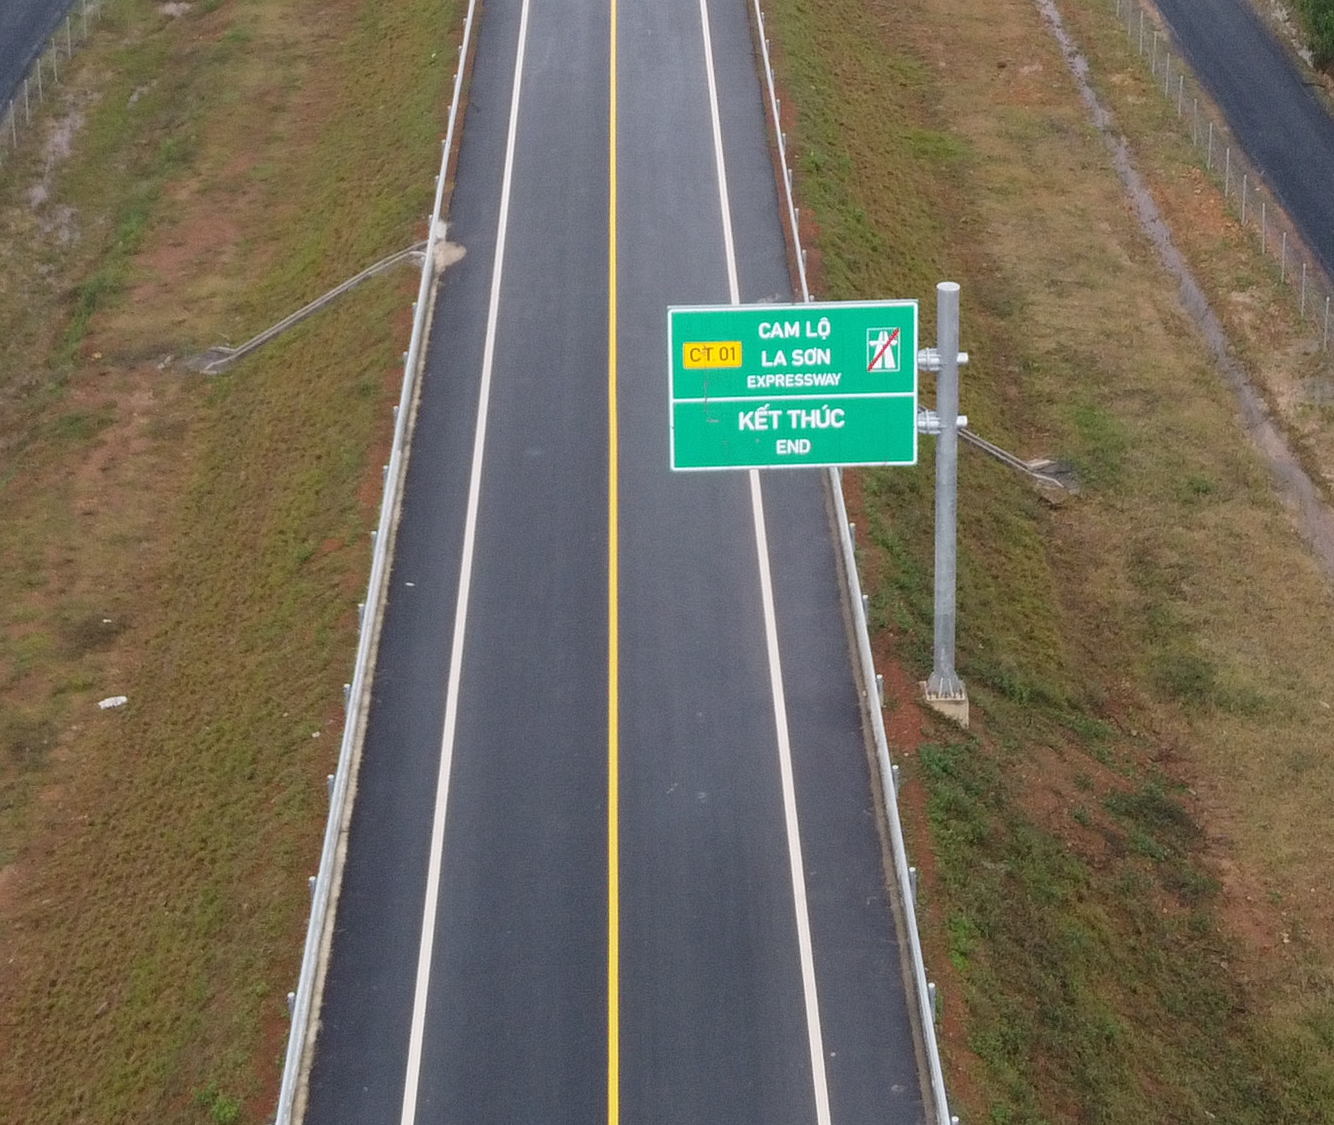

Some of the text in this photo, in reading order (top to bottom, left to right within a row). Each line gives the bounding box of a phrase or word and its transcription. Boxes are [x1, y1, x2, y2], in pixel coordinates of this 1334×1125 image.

[758, 317, 831, 340] CAM LỘ
[761, 347, 831, 367] LA SƠN
[747, 373, 842, 388] EXPRESSWAY
[738, 403, 845, 431] KẾT THÚC
[776, 438, 811, 455] END
